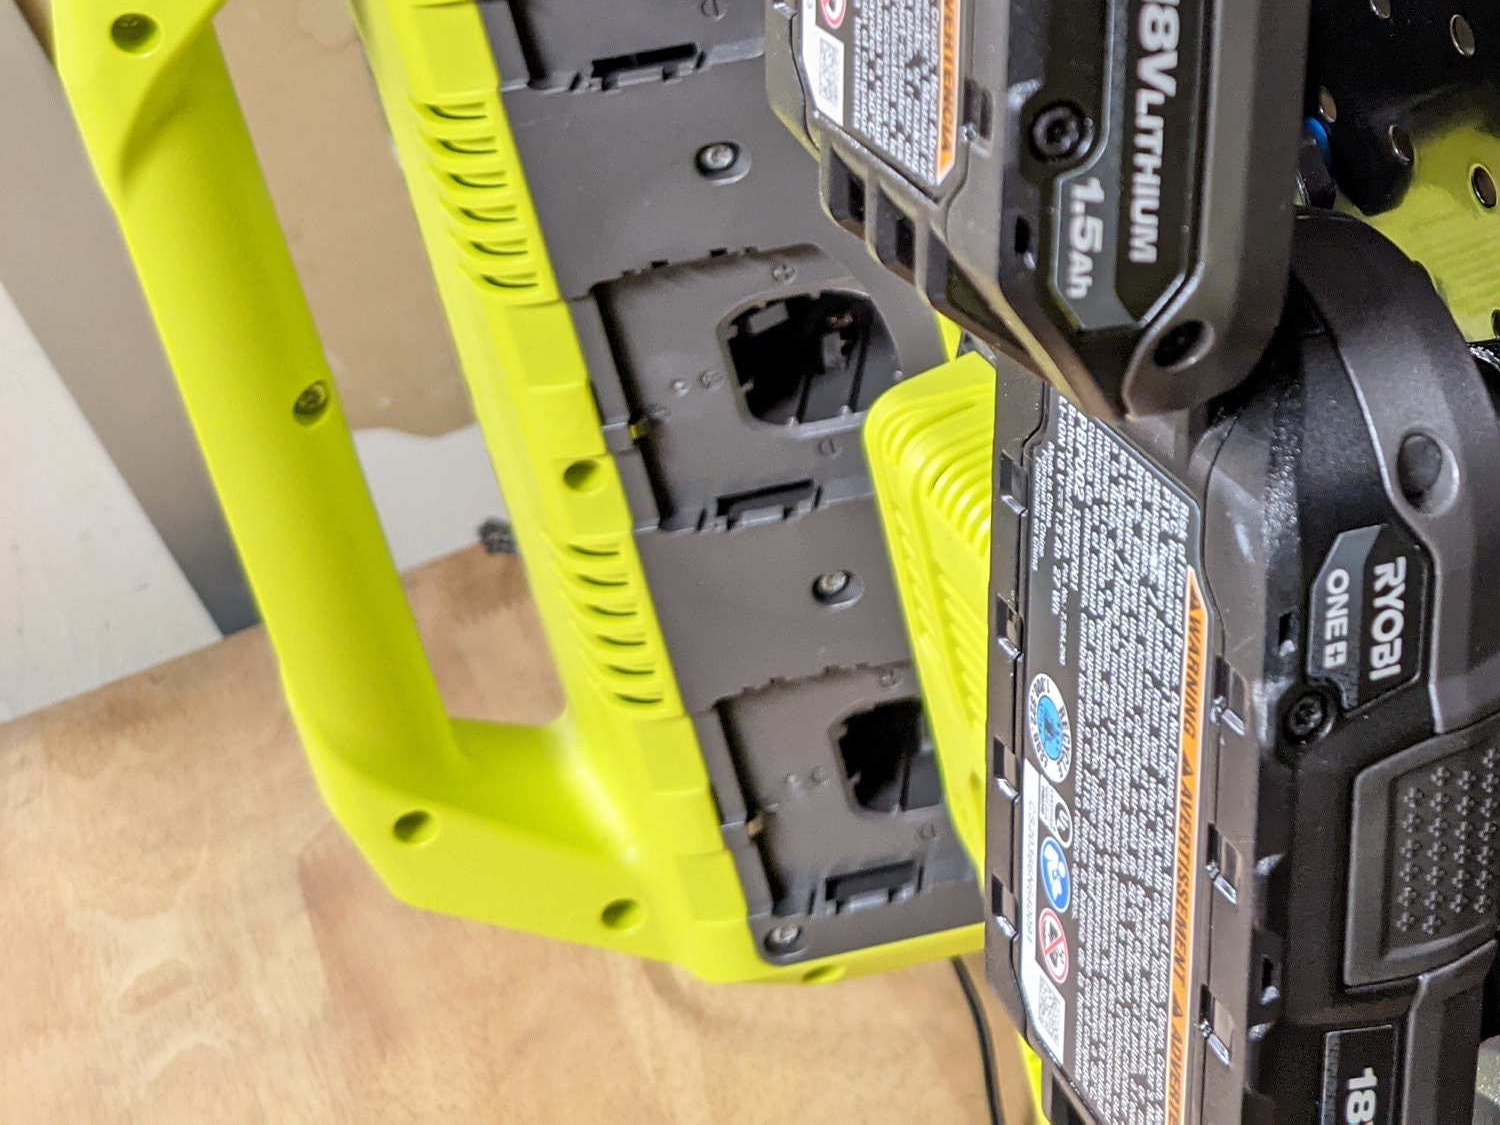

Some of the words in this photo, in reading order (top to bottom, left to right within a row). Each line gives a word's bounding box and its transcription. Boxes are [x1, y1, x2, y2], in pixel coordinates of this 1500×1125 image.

[1129, 88, 1165, 263] LITHIUM
[1066, 177, 1104, 299] 1.5Ah
[1057, 394, 1066, 447] LI-ION
[1074, 410, 1087, 503] PBP002
[1056, 449, 1064, 470] 18
[1053, 535, 1061, 560] Ah
[1054, 509, 1062, 534] 1.5
[1070, 506, 1080, 592] 130597001
[1051, 588, 1060, 616] Wh
[1052, 565, 1060, 587] 27
[1369, 556, 1406, 681] RYOBI
[1183, 613, 1200, 740] WARNING
[1058, 705, 1071, 779] RECYCLE
[1173, 780, 1193, 986] AVERTISSEMENT
[1345, 1067, 1378, 1125] 18
